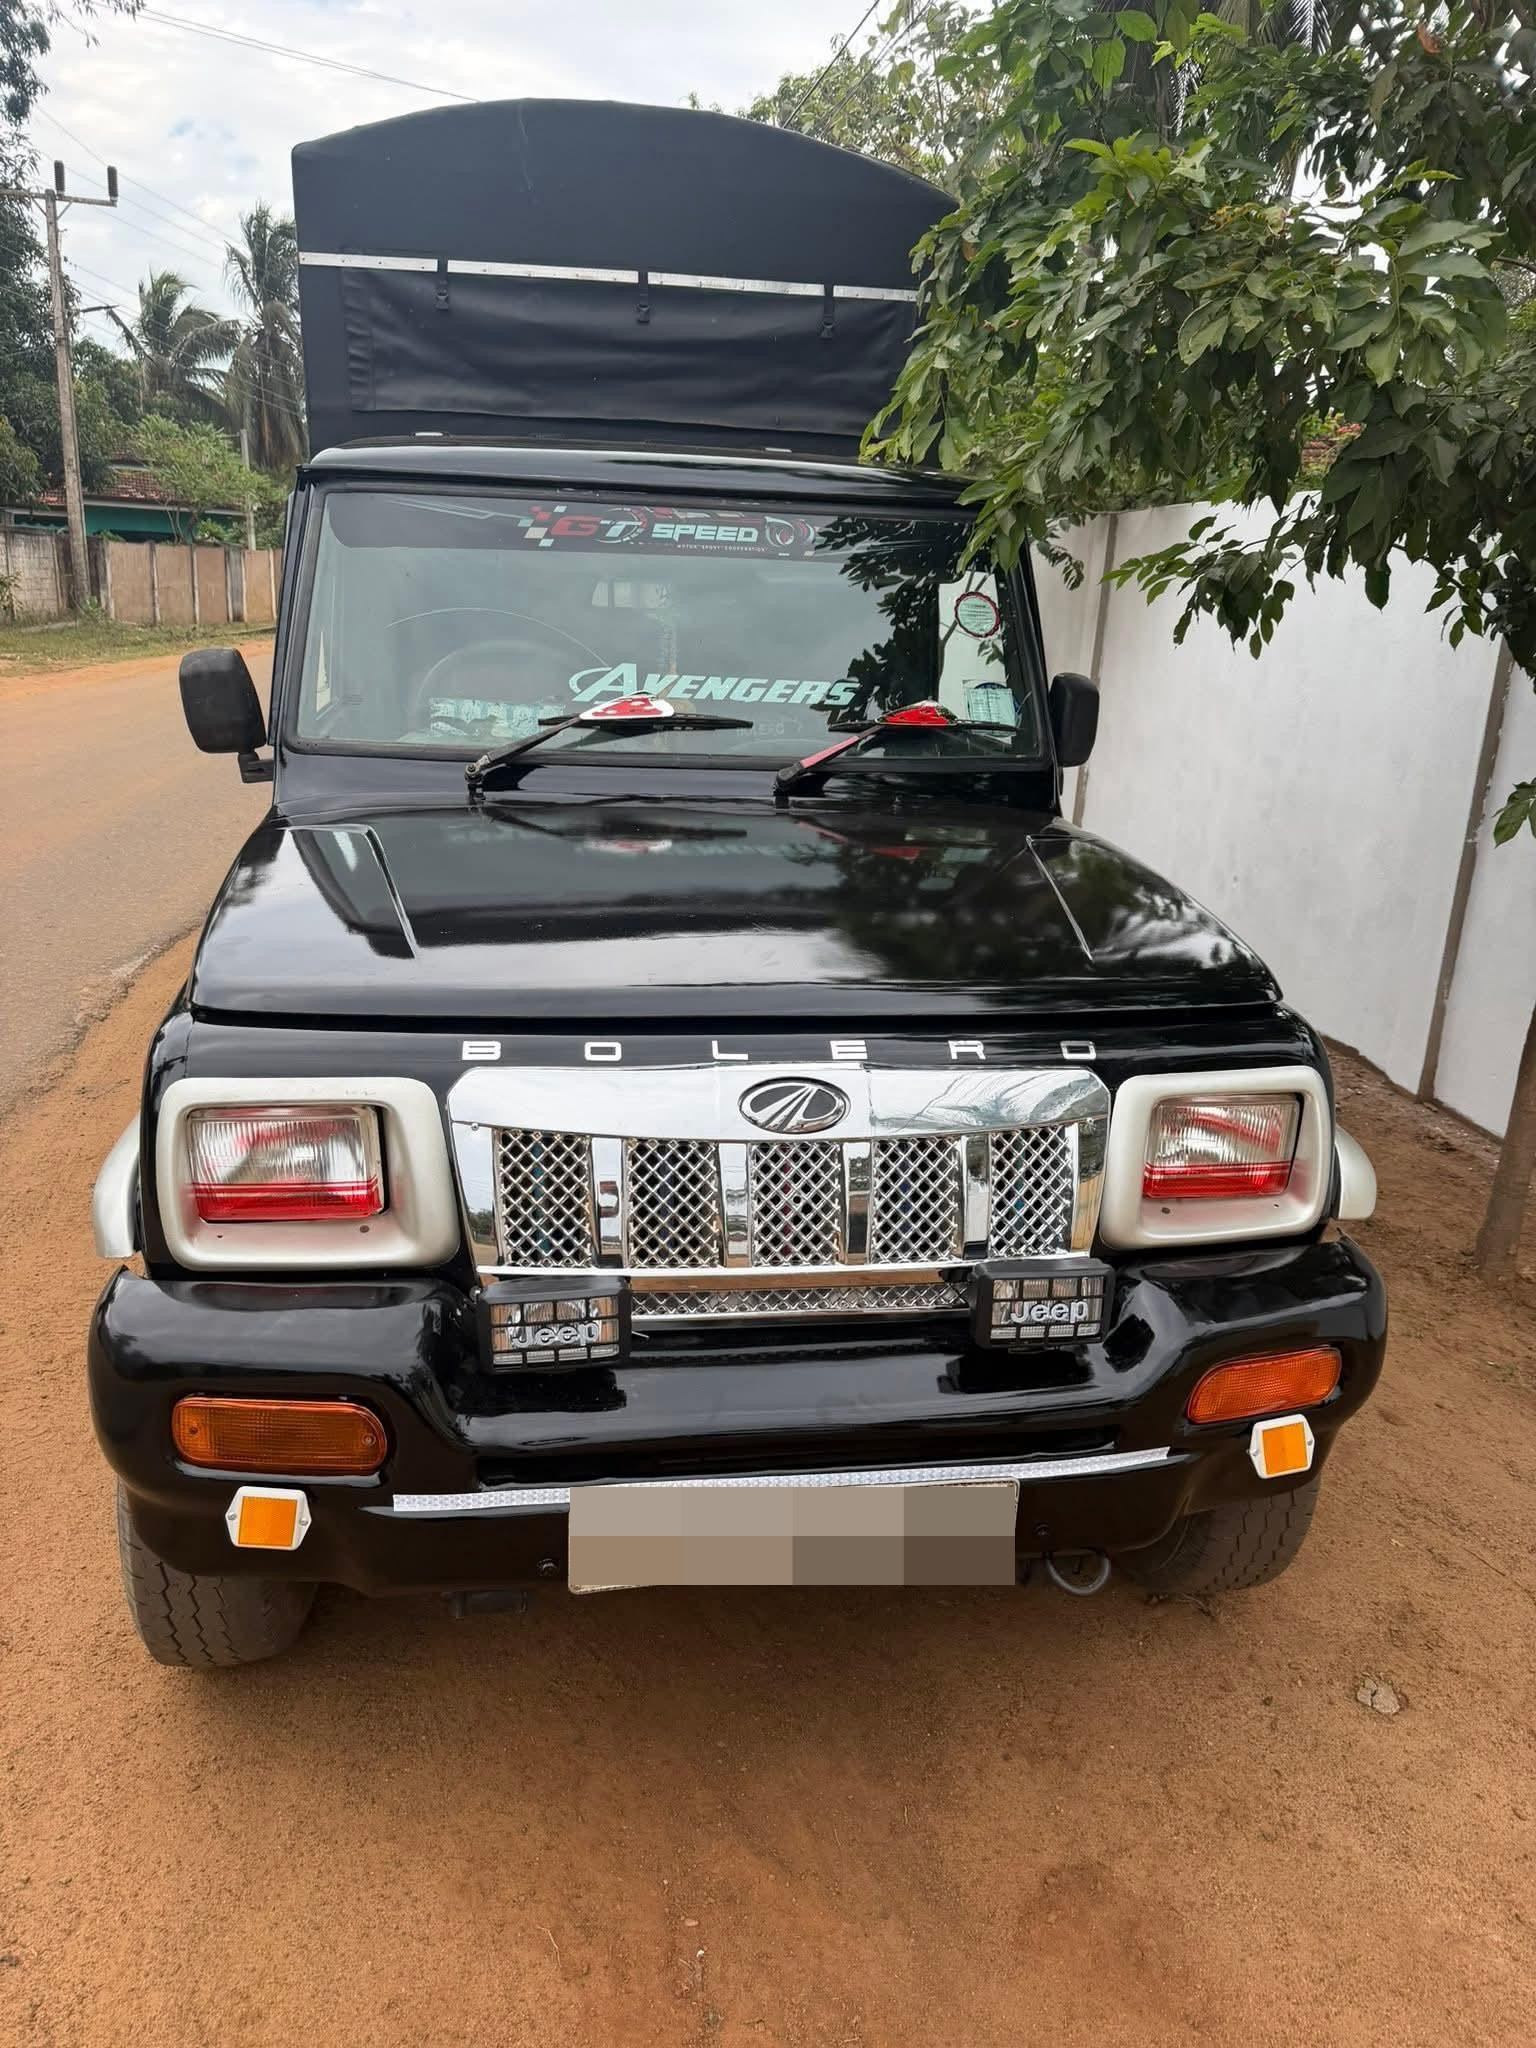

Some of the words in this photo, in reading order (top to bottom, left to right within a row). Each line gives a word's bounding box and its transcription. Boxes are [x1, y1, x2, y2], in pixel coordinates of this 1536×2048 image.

[551, 515, 643, 537] GT
[652, 523, 759, 542] SPEED
[569, 662, 861, 706] AVENGERS
[462, 1040, 1097, 1061] BOLERO
[1010, 1299, 1089, 1324] Jeep
[511, 1320, 600, 1348] Jeep
